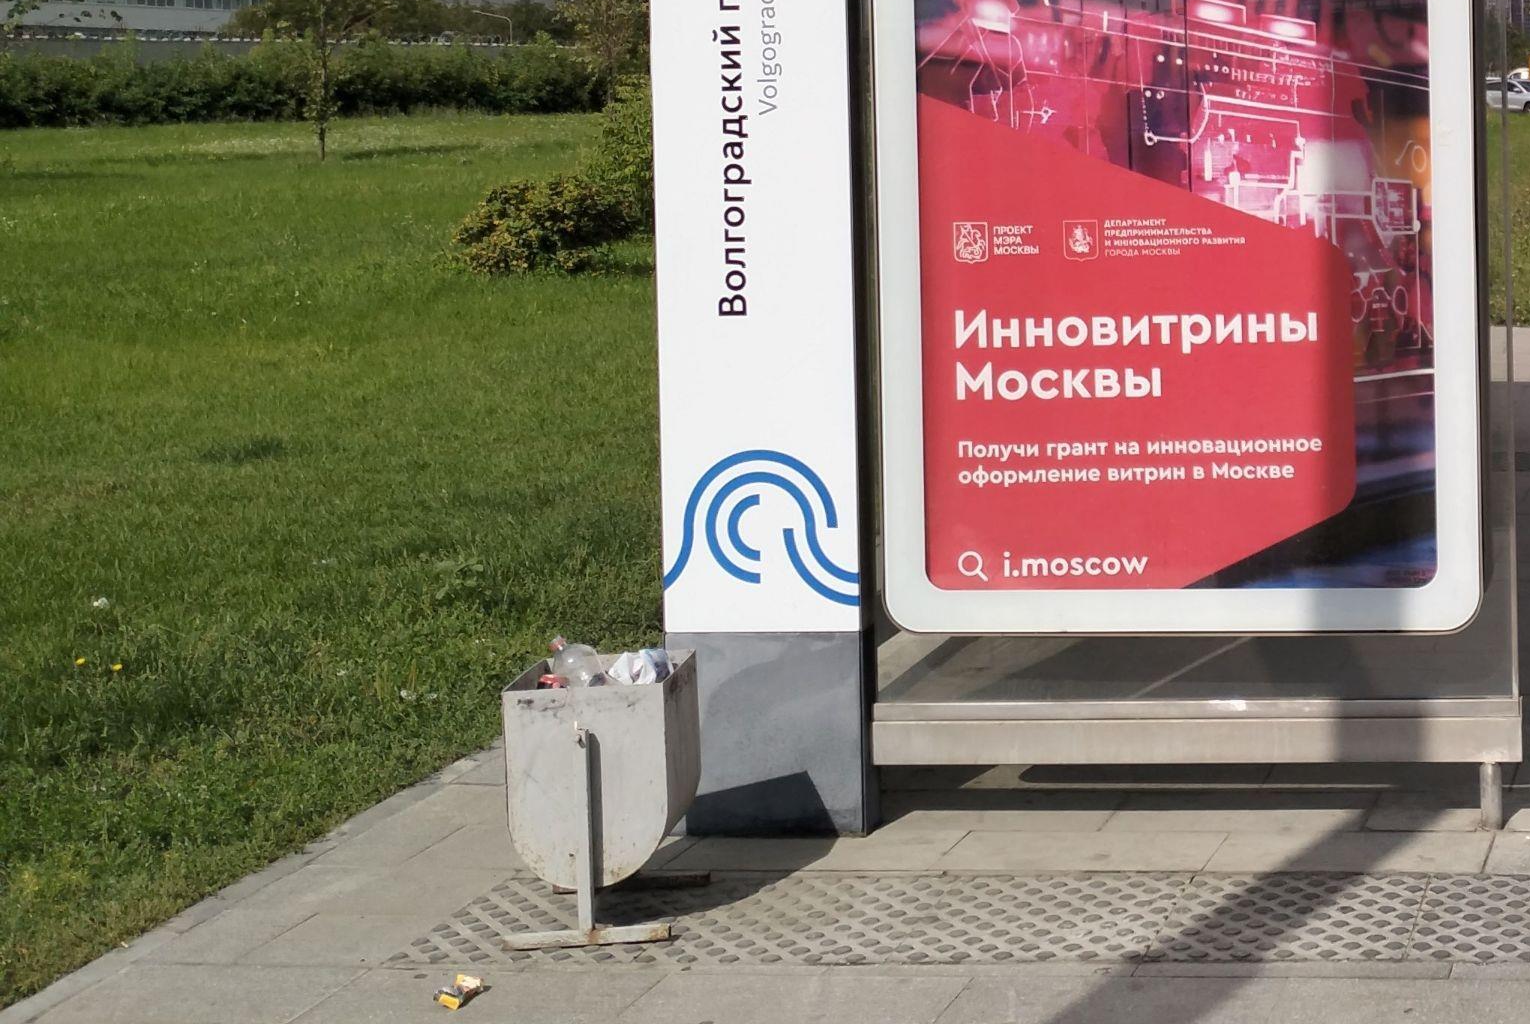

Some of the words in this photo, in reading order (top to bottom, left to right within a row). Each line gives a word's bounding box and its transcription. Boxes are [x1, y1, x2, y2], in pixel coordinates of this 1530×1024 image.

[712, 25, 752, 317] Волгоградский
[1104, 219, 1166, 228] ДЕПАРТАМЕНТ
[993, 225, 1033, 235] ПРОЕКТ
[1104, 227, 1213, 237] ПРЕДПРИНИМАТЕЛЬСТВА
[993, 236, 1023, 246] МЭРА
[1113, 237, 1200, 247] ИННОВАЦИОННОГО
[1202, 236, 1246, 245] РАЗВИТИЯ
[993, 245, 1039, 255] МОСКВЫ
[1104, 248, 1140, 257] ГОРОДА
[1141, 247, 1181, 256] МОСКВЫ
[954, 309, 1319, 354] Инновитрины
[955, 361, 1162, 401] Москвы
[958, 440, 1039, 461] Получи
[1047, 441, 1109, 460] грант
[1115, 442, 1140, 455] на
[1146, 438, 1323, 457] инновационное
[958, 464, 1101, 486] оформление
[1107, 466, 1186, 485] витрин
[1193, 467, 1206, 480] в
[1212, 463, 1295, 480] Москве
[1003, 551, 1149, 578] i.moscow
